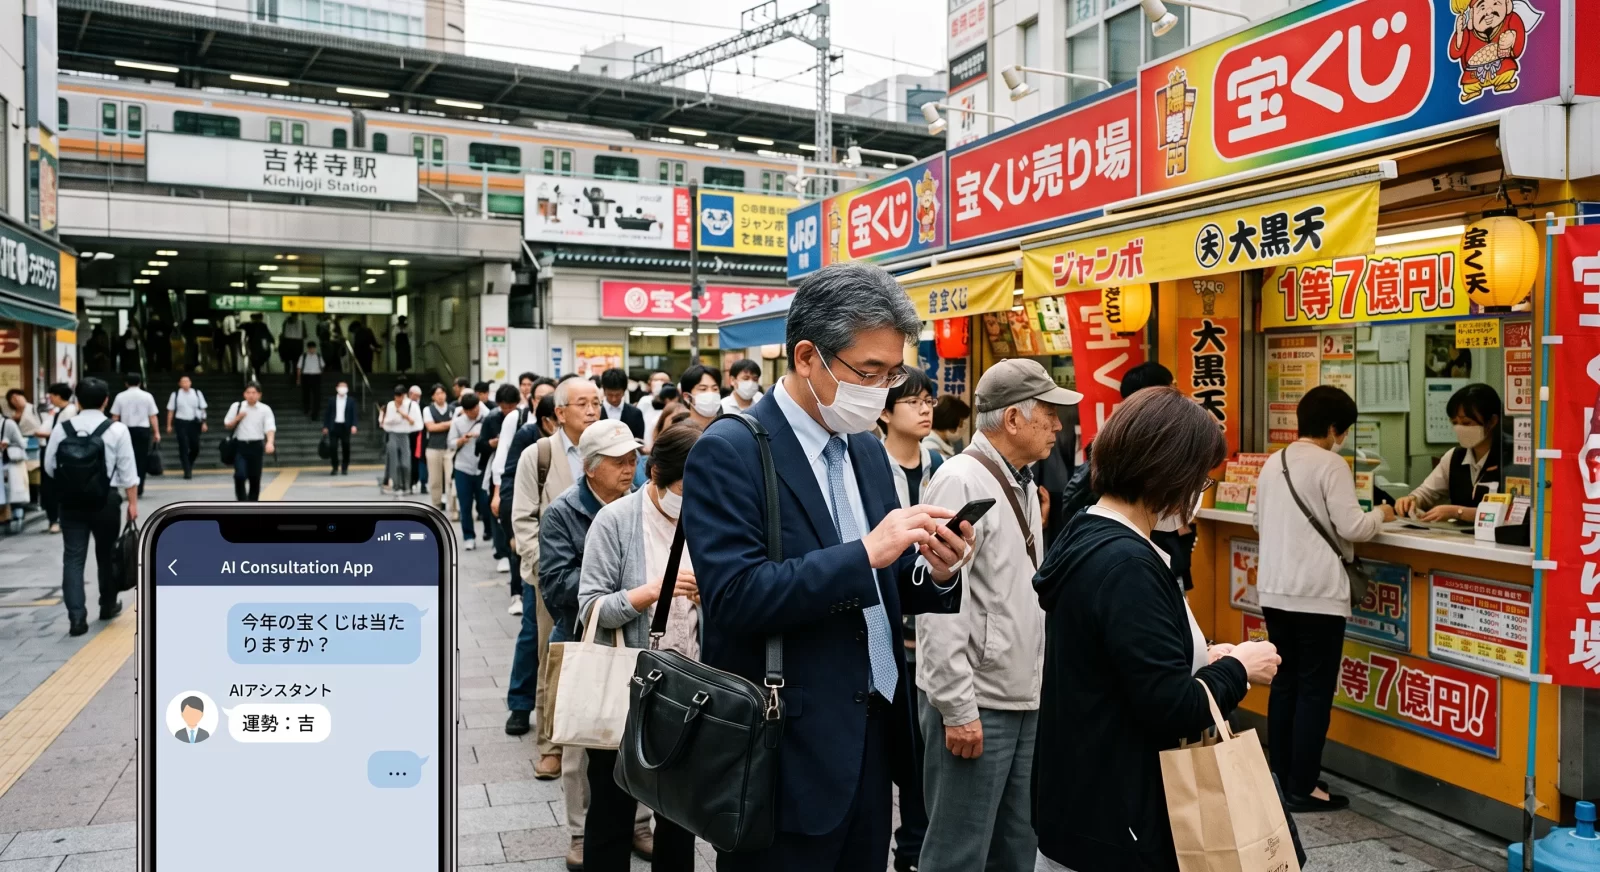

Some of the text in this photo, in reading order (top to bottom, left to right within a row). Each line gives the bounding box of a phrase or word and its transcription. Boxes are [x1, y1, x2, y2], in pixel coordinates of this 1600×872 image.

[1228, 12, 1412, 144] 宝くじ
[263, 149, 377, 179] 吉祥寺駅
[263, 175, 377, 195] Kichijoji Station
[956, 117, 1132, 222] 宝くじ売り場
[851, 192, 908, 250] 宝くじ
[1052, 238, 1145, 289] ジャンボ
[1228, 206, 1325, 262] 大黒天
[1279, 251, 1454, 321] 1等7億円!
[1463, 227, 1490, 294] 宝く天
[1191, 319, 1227, 421] 大黒天
[221, 560, 373, 577] AI Consultation App
[242, 613, 404, 631] 今年の宝くじは当た
[245, 637, 328, 653] りますか？
[230, 684, 331, 697] AIアシスタント
[1334, 651, 1489, 737] 等7億円!
[243, 715, 314, 732] 運勢：吉
